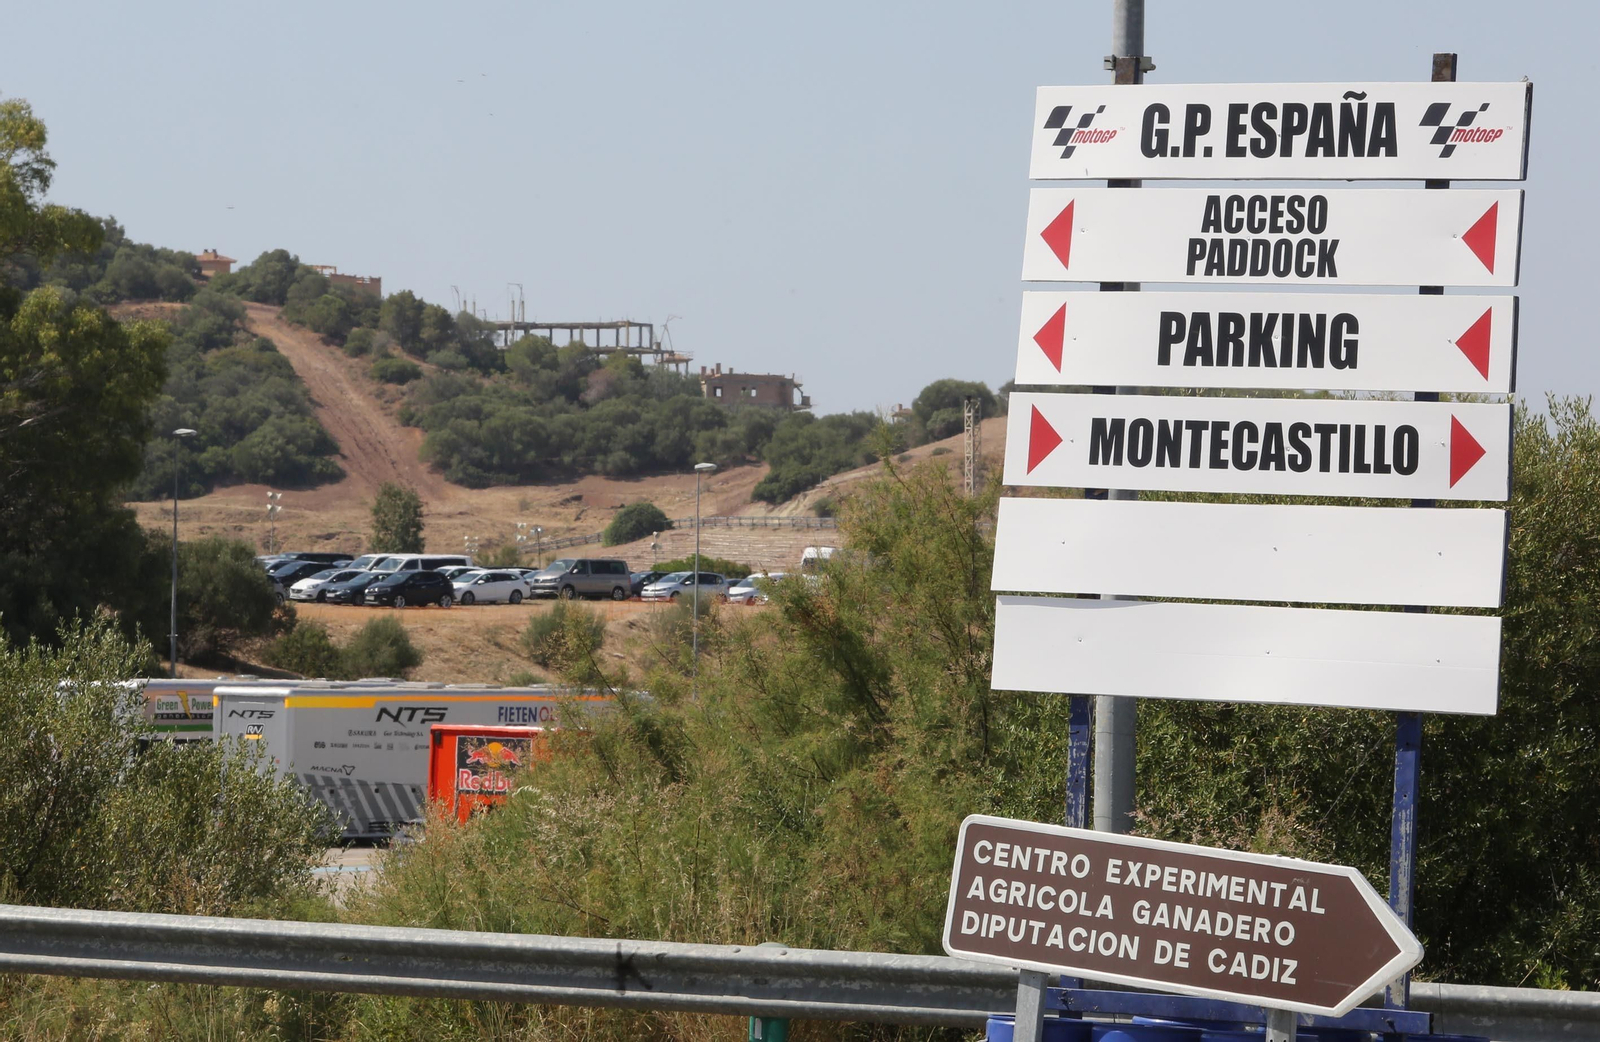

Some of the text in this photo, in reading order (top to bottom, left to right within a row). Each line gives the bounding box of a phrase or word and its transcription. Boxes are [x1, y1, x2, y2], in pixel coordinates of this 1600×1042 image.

[1140, 90, 1397, 158] G.P. ESPAÑA
[1201, 195, 1328, 234] ACCESO
[1186, 238, 1340, 279] PADDOCK
[1157, 311, 1360, 370] PARKING
[1088, 417, 1420, 476] MONTECASTILLO
[156, 698, 179, 711] Green
[228, 709, 275, 719] NTS
[375, 706, 448, 728] NTS
[498, 706, 538, 722] FIETEN
[459, 769, 493, 791] Red
[973, 839, 1326, 915] CENTRO EXPERIMENTAL
[966, 875, 1295, 946] AGRICOLA GANADERO
[960, 910, 1298, 985] DIPUTACION DE CADIZ
